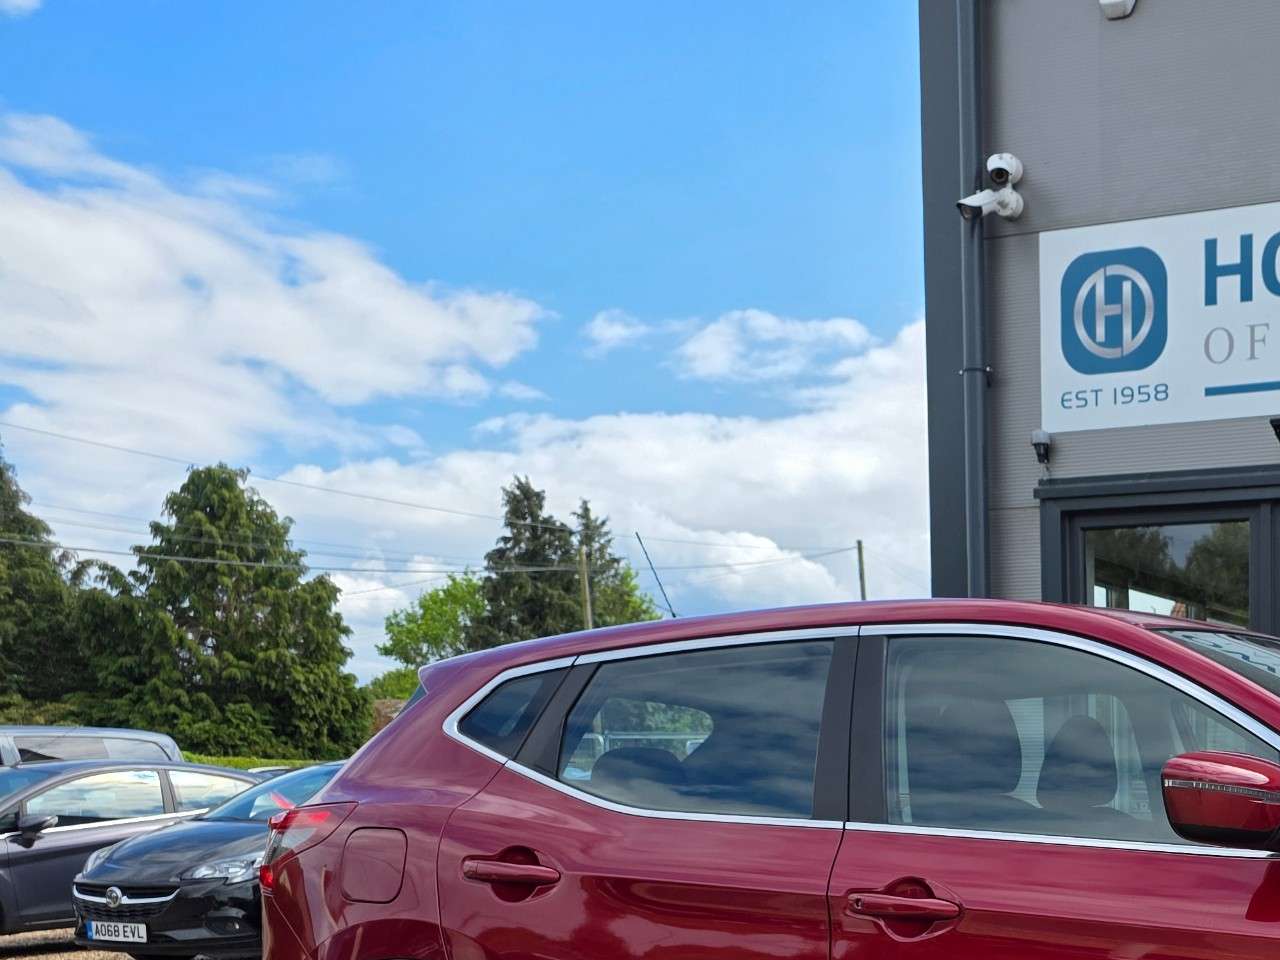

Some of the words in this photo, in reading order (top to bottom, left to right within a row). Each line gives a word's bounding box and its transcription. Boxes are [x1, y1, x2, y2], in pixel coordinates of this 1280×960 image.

[1204, 323, 1271, 364] OF
[1061, 388, 1104, 410] EST
[1113, 383, 1169, 406] 1958
[95, 924, 120, 937] AO68
[123, 925, 143, 938] EVL
